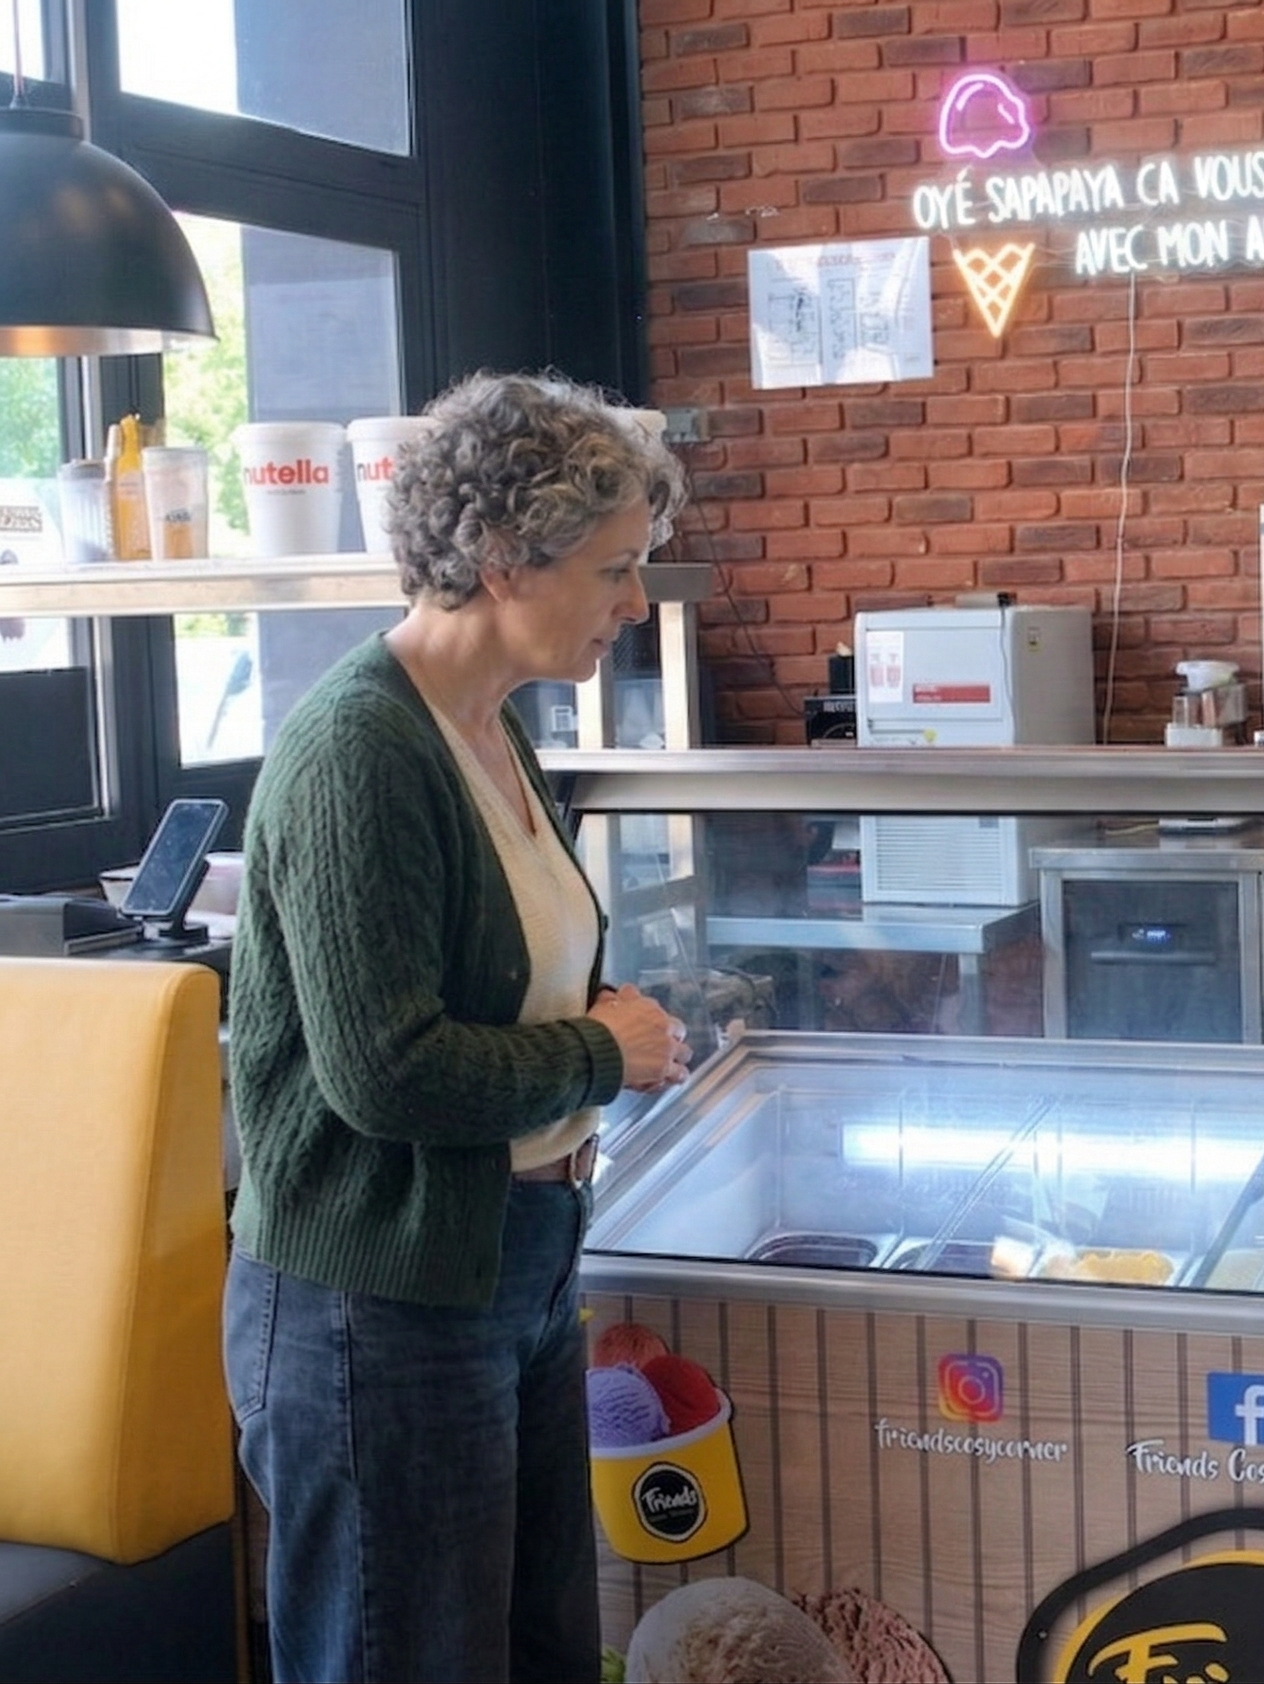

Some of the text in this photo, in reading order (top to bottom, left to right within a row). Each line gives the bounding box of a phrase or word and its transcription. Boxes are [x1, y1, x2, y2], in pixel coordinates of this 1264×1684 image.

[912, 166, 977, 230] OYÉ
[986, 165, 1124, 223] SAPAPAYA
[1136, 160, 1181, 206] CA
[1075, 224, 1148, 276] AVEC
[1157, 219, 1230, 268] MON
[244, 458, 330, 485] nutella
[874, 1417, 1068, 1465] friendscosycorner
[1126, 1438, 1220, 1481] Friends
